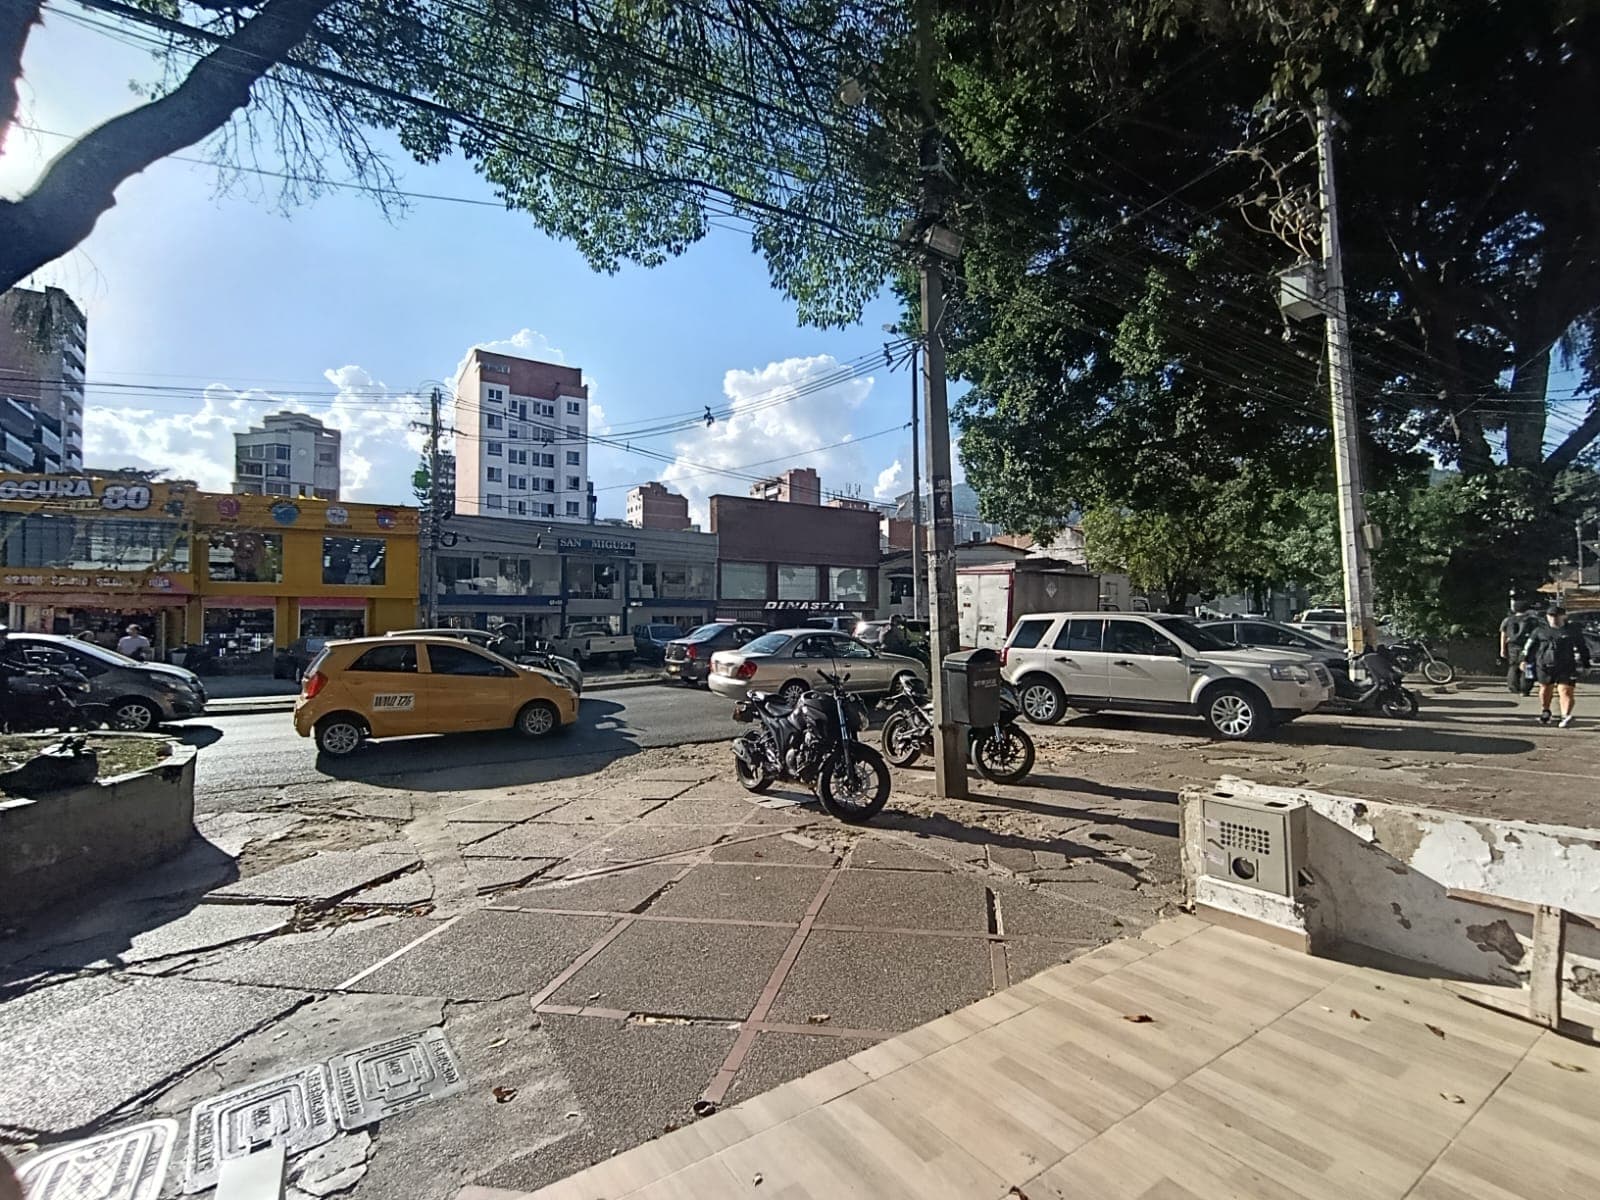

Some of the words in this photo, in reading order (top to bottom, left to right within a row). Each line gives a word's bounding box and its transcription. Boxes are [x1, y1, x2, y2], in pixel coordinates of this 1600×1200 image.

[103, 486, 150, 510] 80
[560, 538, 582, 547] SAN
[591, 540, 635, 550] MIGUEL
